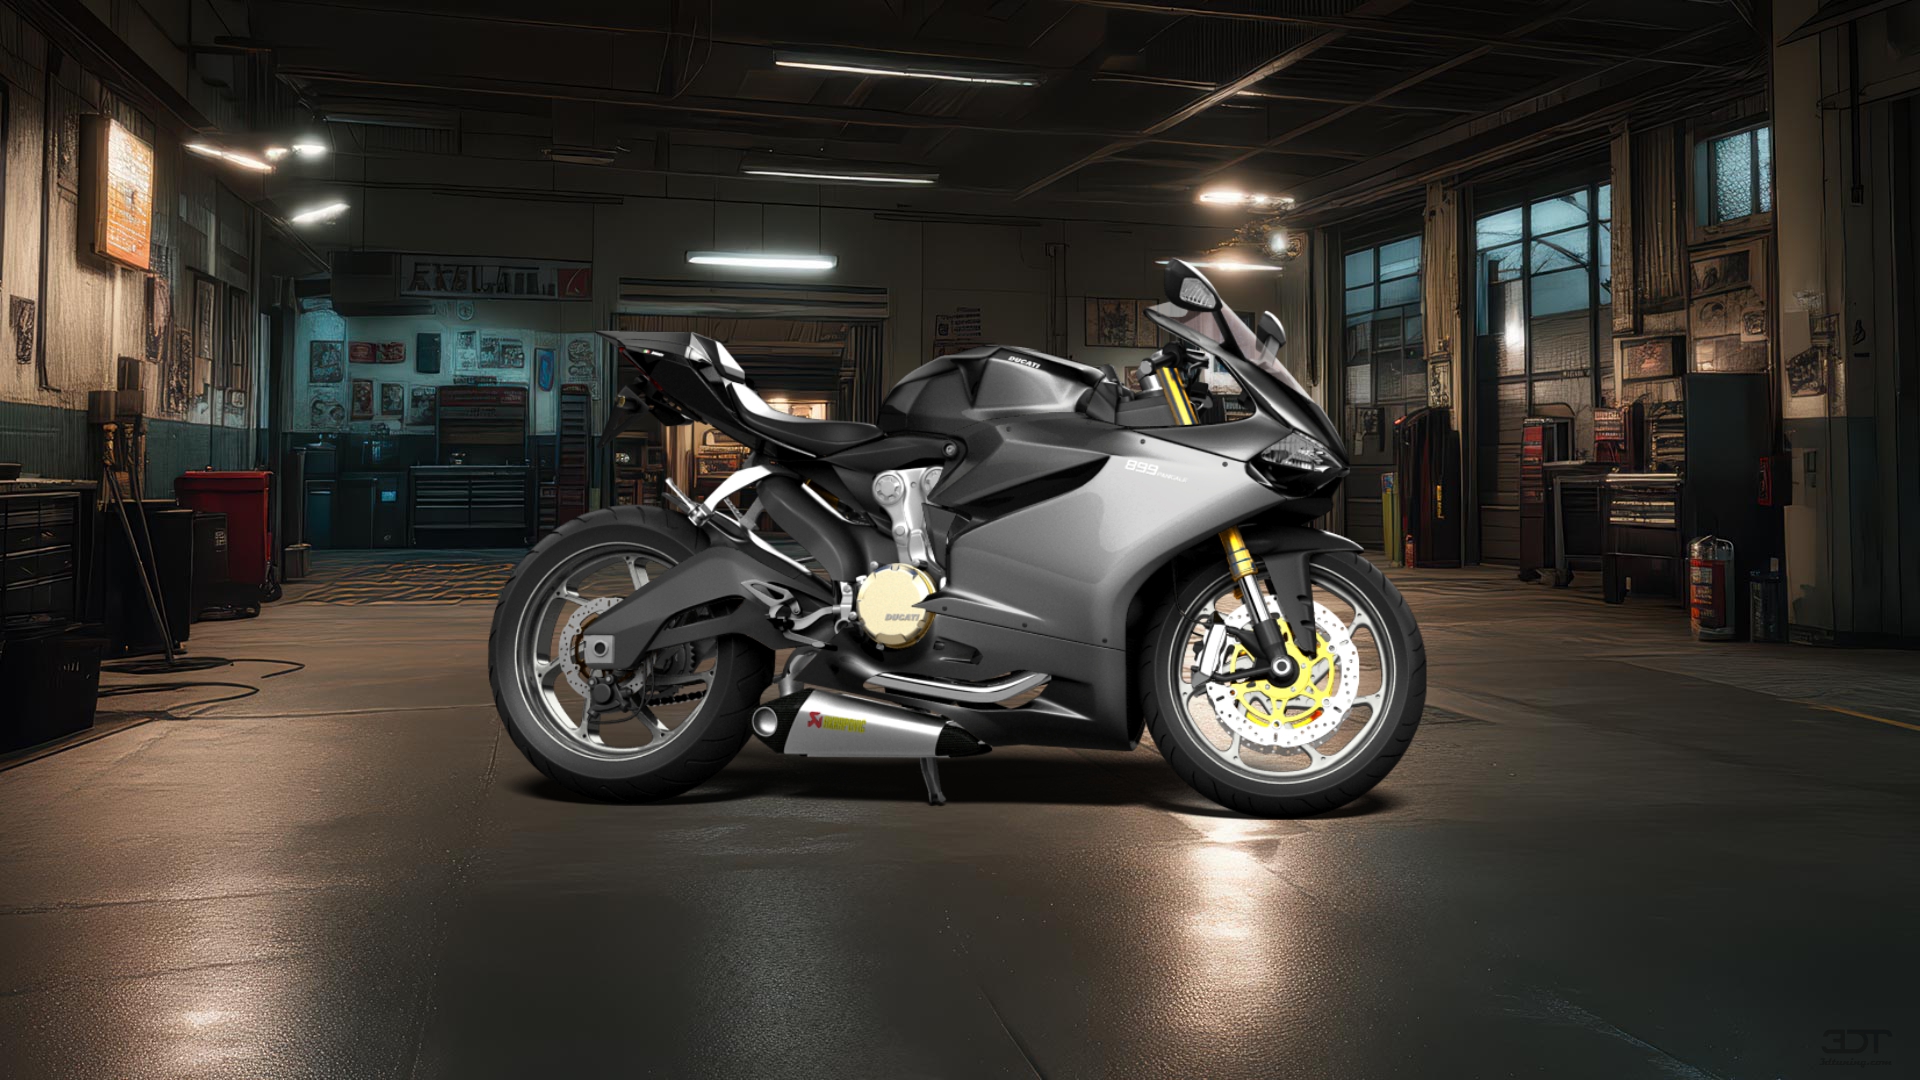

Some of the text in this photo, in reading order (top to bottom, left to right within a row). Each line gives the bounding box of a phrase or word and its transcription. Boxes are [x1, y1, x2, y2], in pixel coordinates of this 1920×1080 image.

[1008, 356, 1041, 369] DUCATI
[1125, 459, 1159, 476] 899
[885, 613, 920, 621] DUCATI
